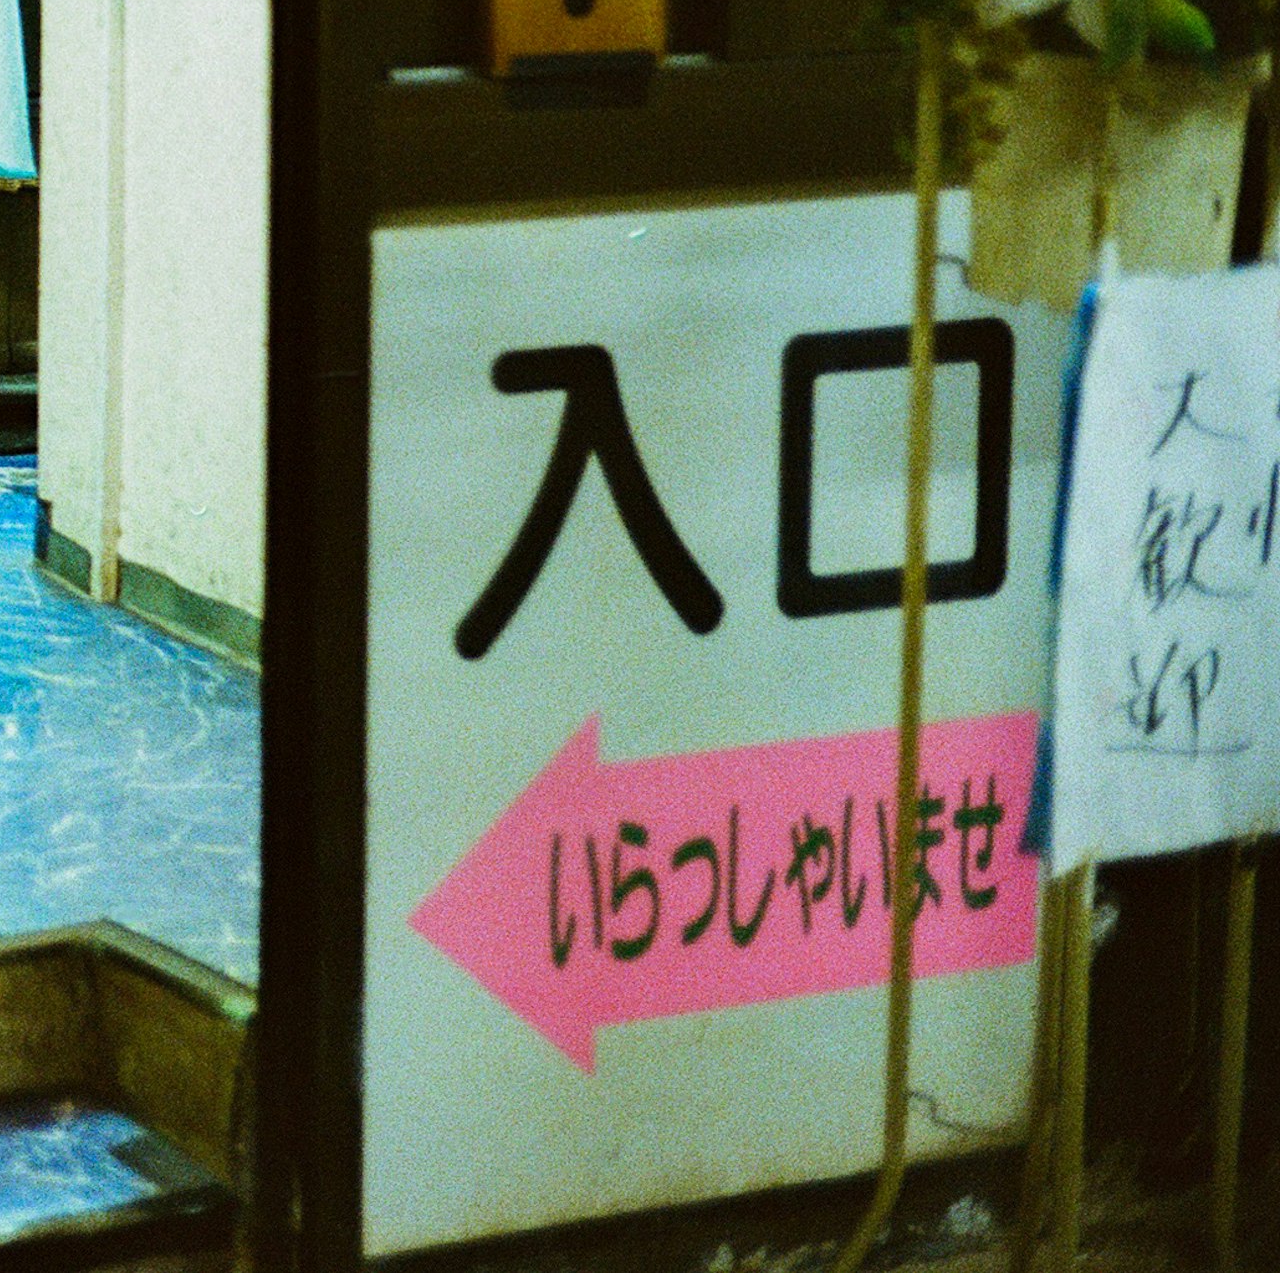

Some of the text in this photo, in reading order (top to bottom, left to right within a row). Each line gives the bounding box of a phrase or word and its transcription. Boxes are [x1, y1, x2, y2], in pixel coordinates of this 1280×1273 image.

[455, 317, 1016, 661] 入口
[1109, 370, 1252, 757] 大歓迎
